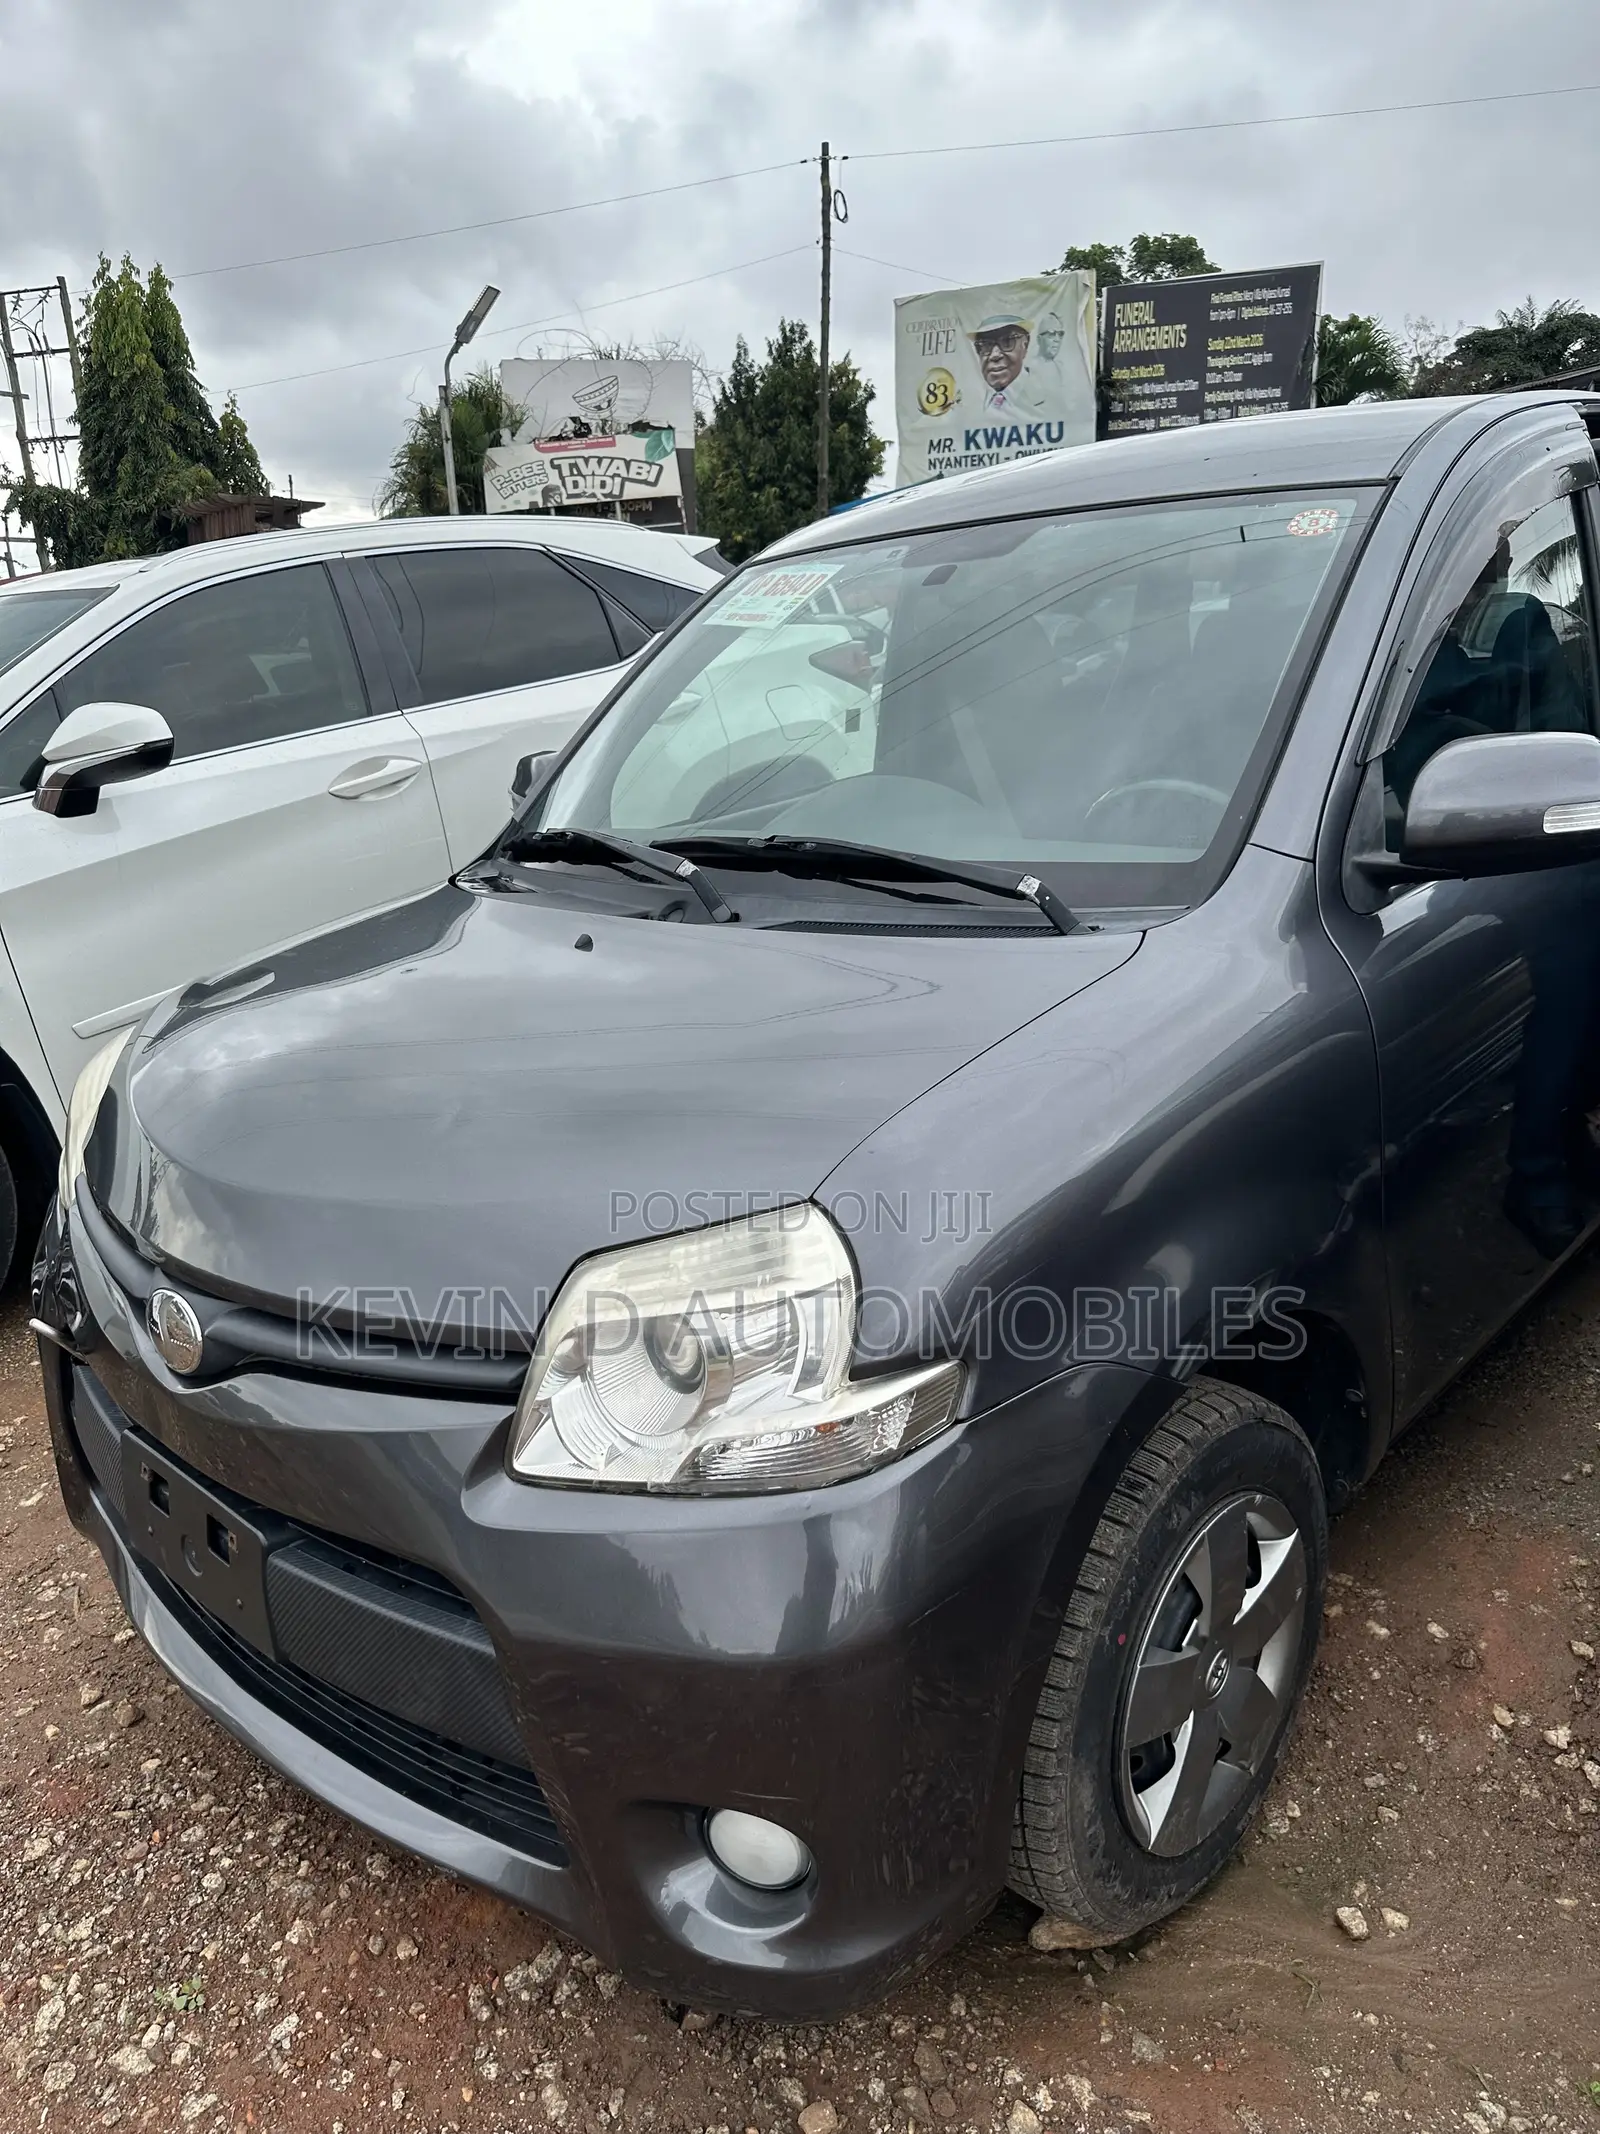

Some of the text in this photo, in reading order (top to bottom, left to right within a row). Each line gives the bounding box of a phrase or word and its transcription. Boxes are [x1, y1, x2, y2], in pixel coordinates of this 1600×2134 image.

[1114, 300, 1156, 328] FUNERAL
[921, 328, 956, 356] LIFE
[1112, 323, 1187, 353] ARRANGEMENTS
[926, 382, 948, 407] 83
[928, 421, 1064, 455] MR. KWAKU
[551, 456, 664, 487] TWABI
[928, 452, 1000, 471] NYANTEKYI
[499, 473, 549, 500] BITTERS
[563, 475, 624, 499] DIDI
[609, 500, 653, 512] 800PM
